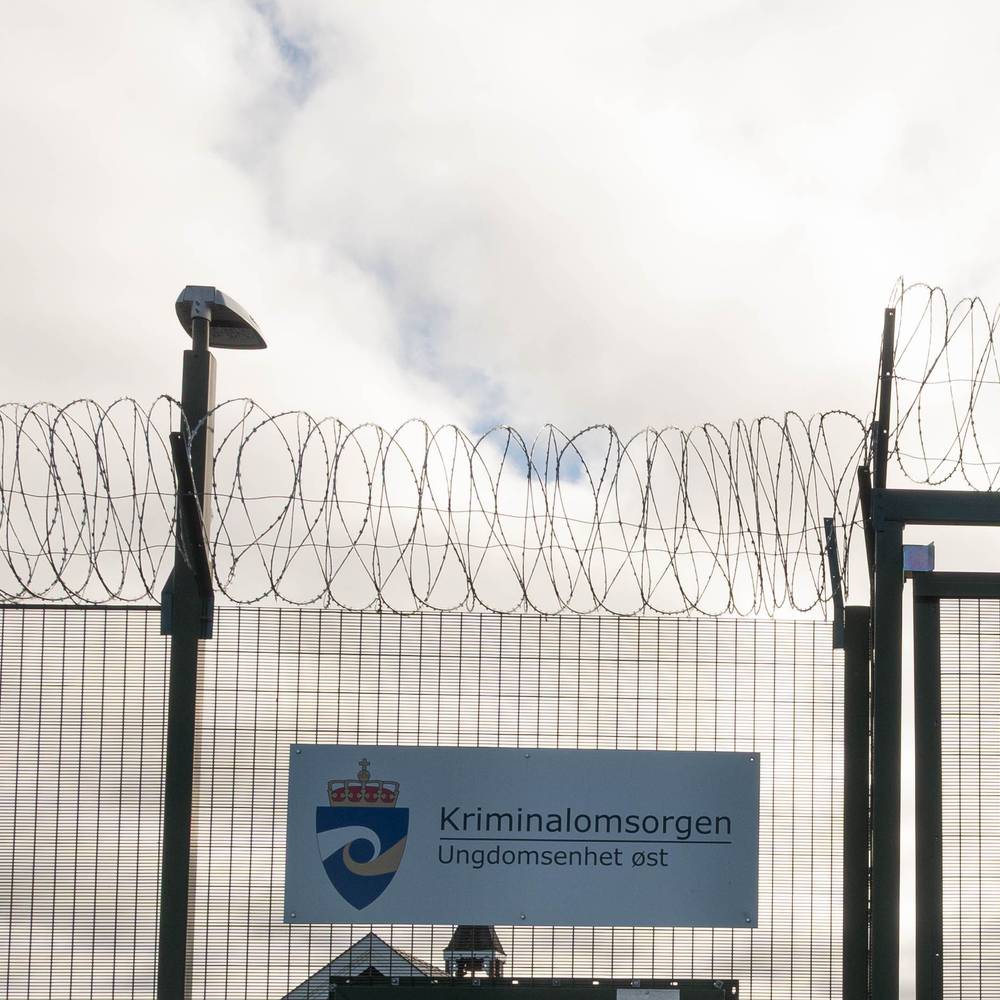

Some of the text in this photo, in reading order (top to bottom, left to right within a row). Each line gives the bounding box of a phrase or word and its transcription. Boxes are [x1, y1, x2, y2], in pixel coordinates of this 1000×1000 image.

[440, 806, 732, 840] Kriminalomsorgen
[438, 845, 669, 870] Ungdomsenhet øst
